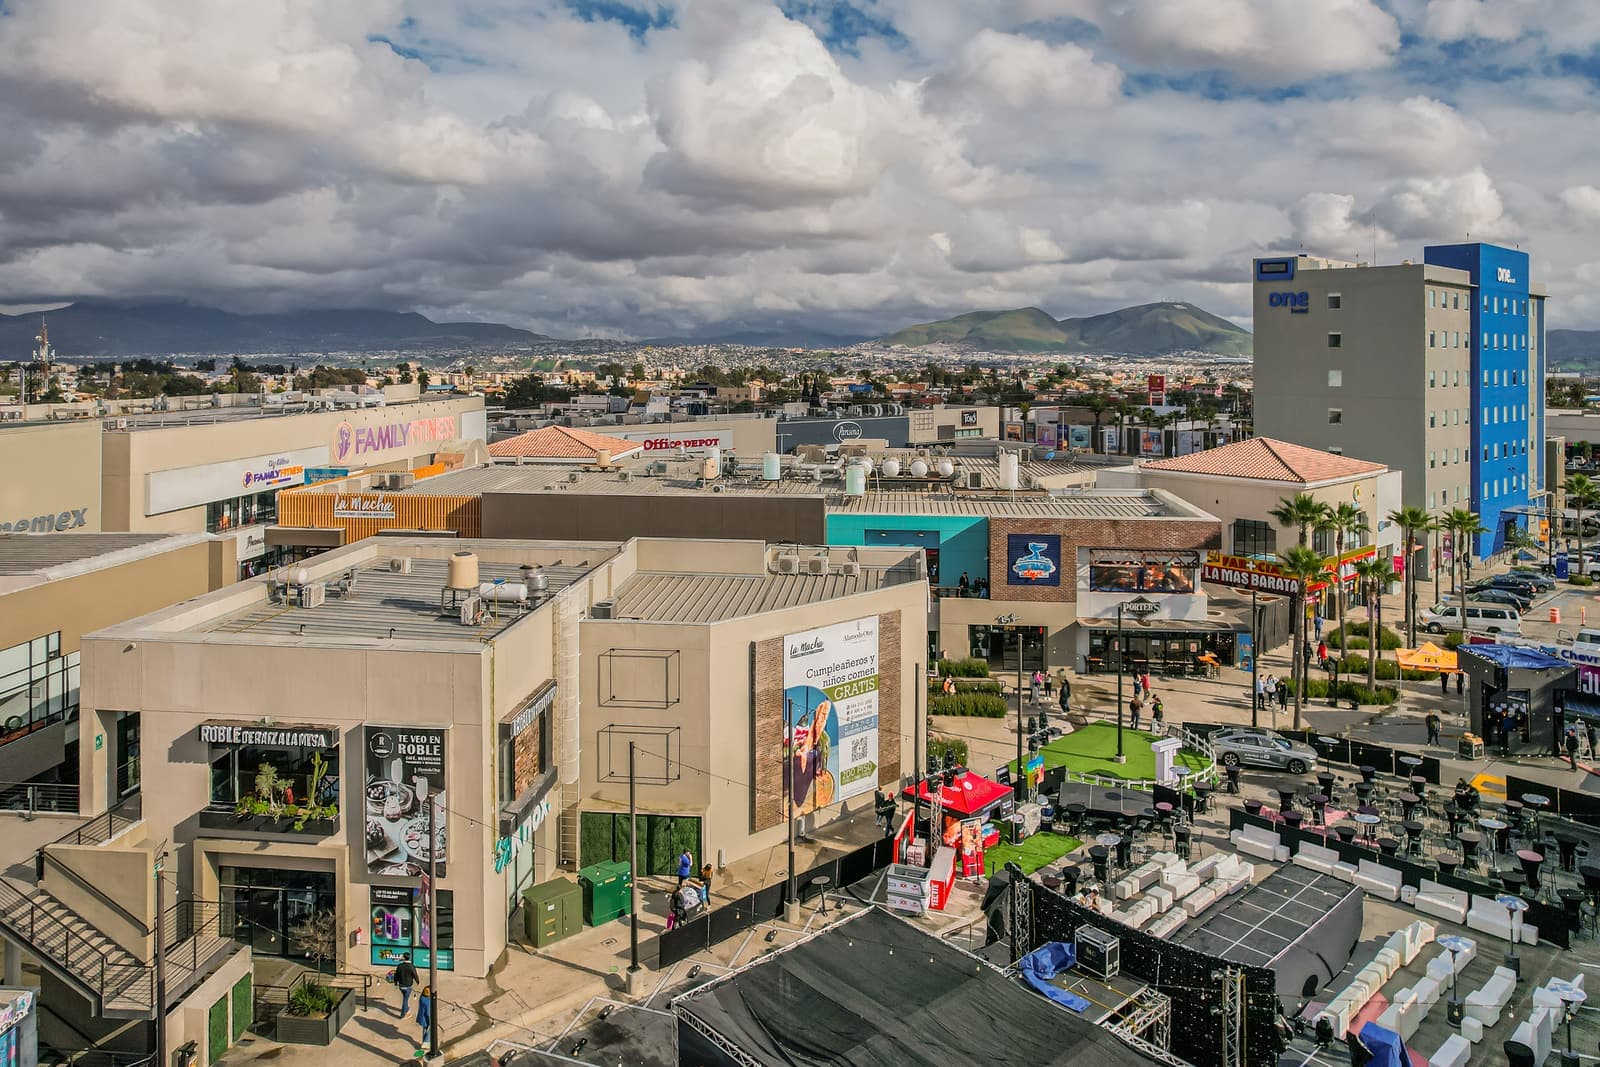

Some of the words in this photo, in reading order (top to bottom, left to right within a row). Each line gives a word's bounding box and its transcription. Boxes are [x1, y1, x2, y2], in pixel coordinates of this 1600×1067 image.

[1497, 267, 1511, 283] one
[1269, 291, 1309, 307] one
[643, 438, 682, 451] Office
[683, 438, 720, 448] DEPOT
[334, 494, 349, 511] La
[351, 492, 394, 512] Macha
[1204, 566, 1220, 580] LA
[1221, 568, 1249, 585] MAS
[1251, 573, 1299, 593] BARATA
[1122, 601, 1161, 614] PORTER'S
[806, 656, 868, 679] Cumpleañeros
[869, 654, 876, 665] y
[822, 674, 846, 688] niños
[847, 666, 876, 681] comen
[834, 678, 876, 701] GRATIS
[201, 725, 242, 744] ROBLE
[397, 734, 409, 743] TE
[410, 735, 427, 744] VEO
[429, 735, 441, 744] EN
[397, 743, 441, 756] ROBLE
